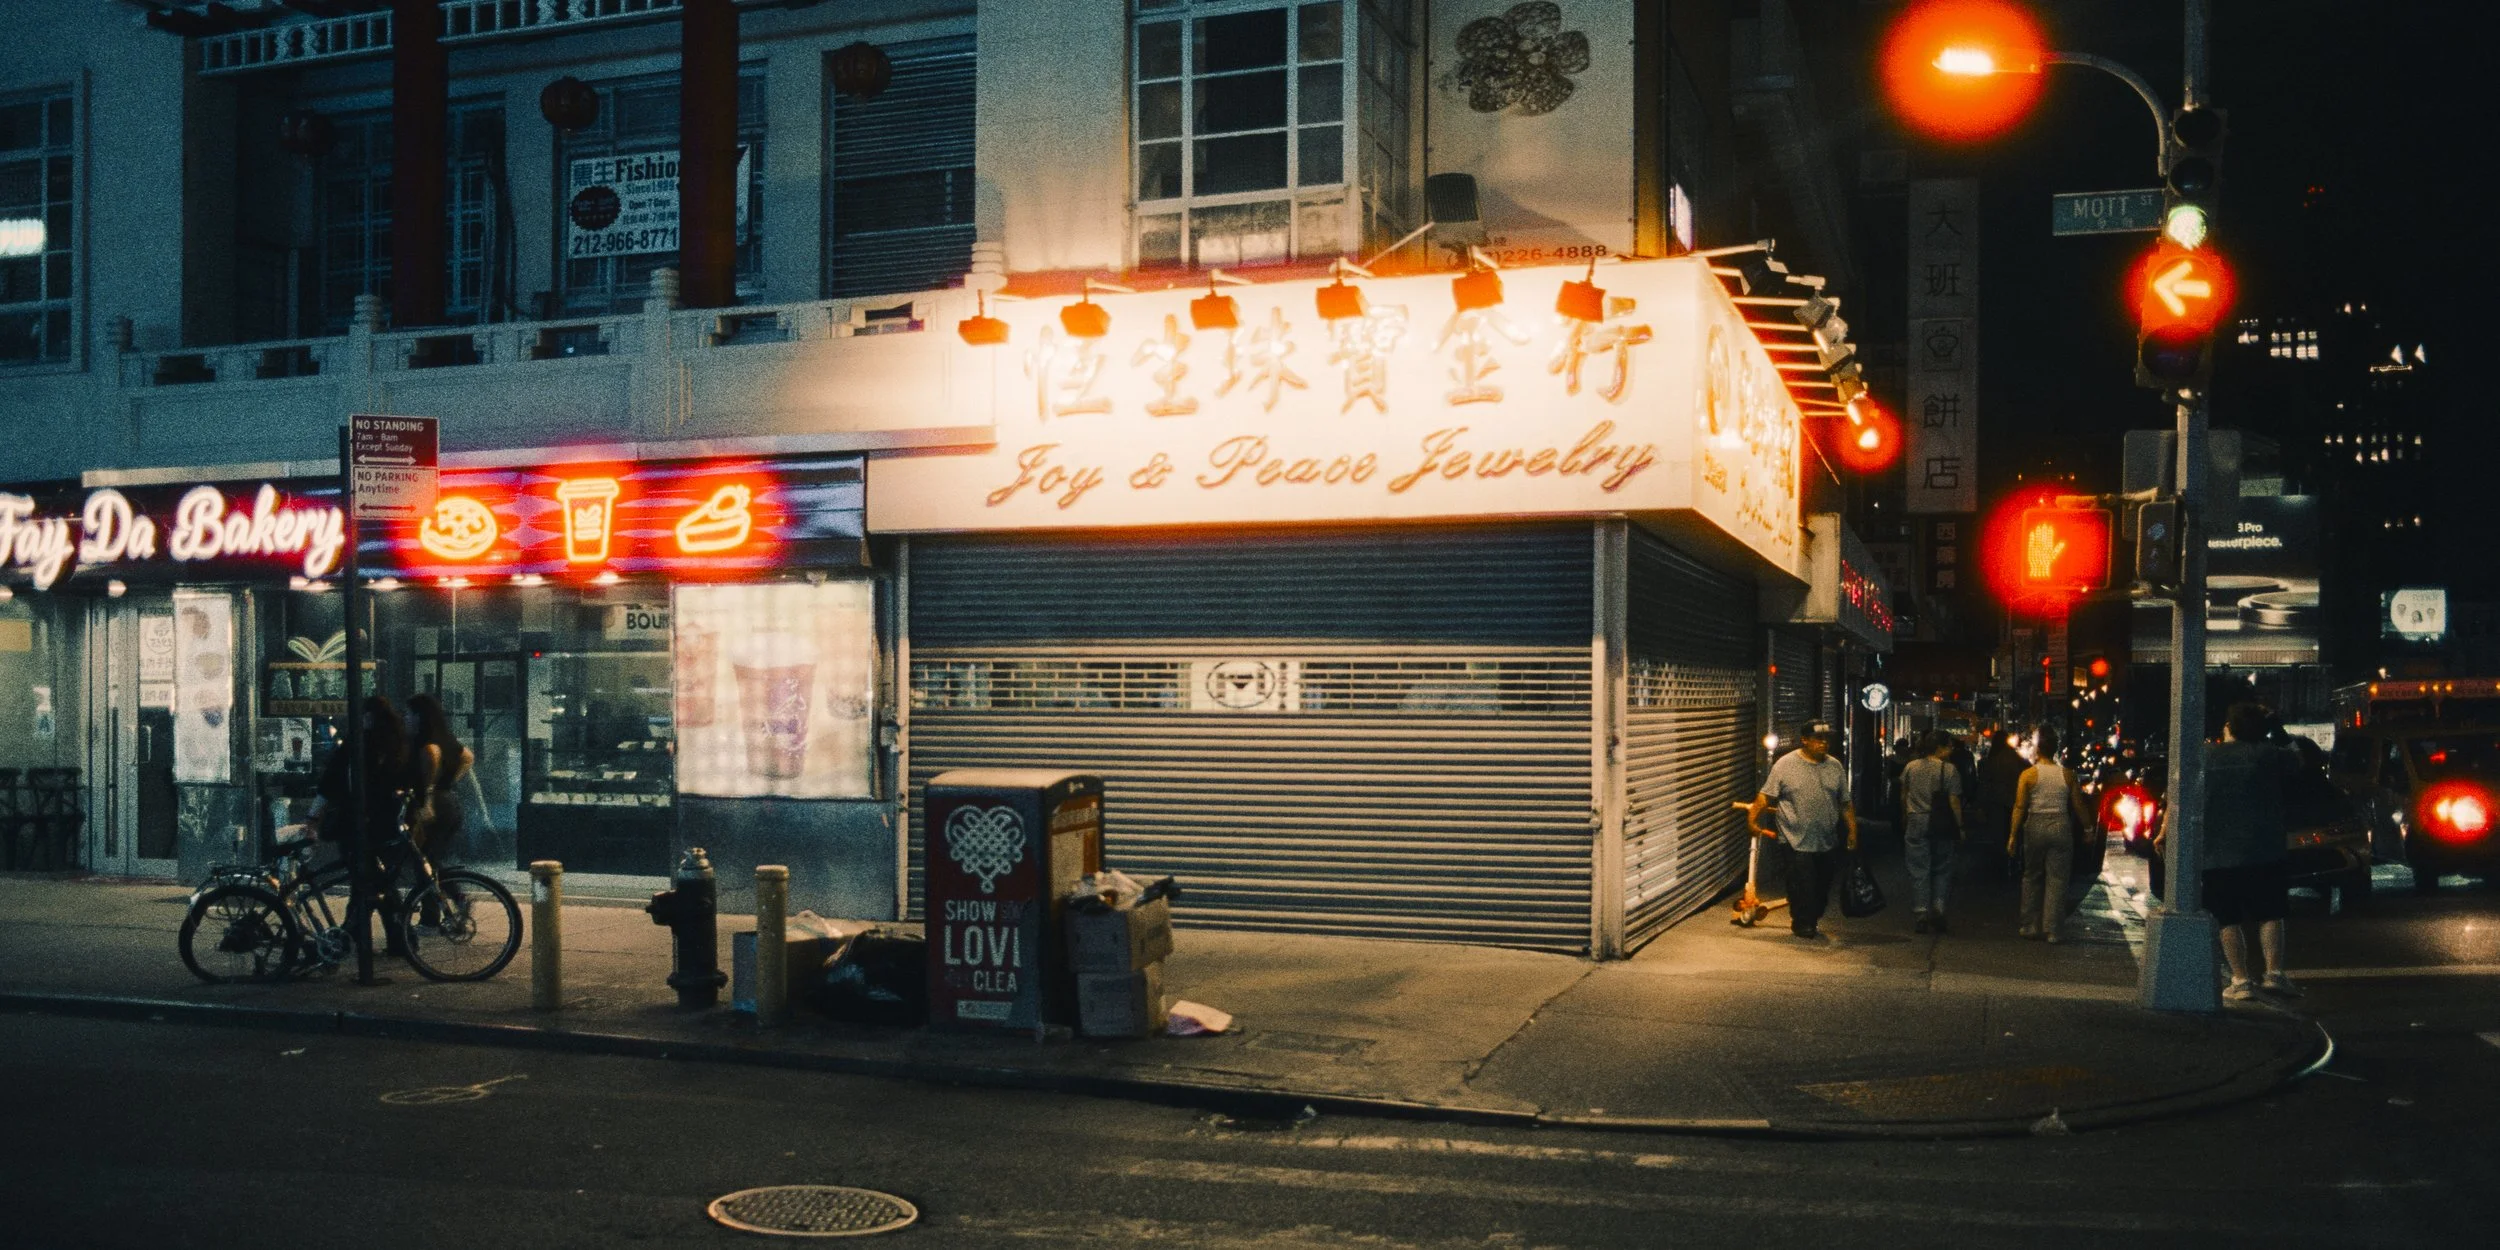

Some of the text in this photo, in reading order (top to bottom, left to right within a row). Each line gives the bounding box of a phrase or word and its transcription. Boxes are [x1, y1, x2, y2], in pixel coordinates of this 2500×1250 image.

[626, 183, 650, 195] Since
[629, 200, 646, 211] Open
[654, 198, 671, 210] Days
[2073, 194, 2154, 219] MOTT ST
[573, 227, 678, 255] 212-966-8771
[355, 420, 425, 432] NO STANDING
[357, 432, 374, 441] 7am
[356, 442, 414, 454] Except Sunday
[986, 441, 1104, 510] Joy
[1129, 451, 1175, 490] &
[1196, 434, 1378, 489] Peace
[1388, 419, 1657, 494] Jewelry
[357, 471, 420, 483] NO PARKING
[358, 484, 401, 495] Anytime
[2245, 522, 2264, 533] Pro
[0, 483, 346, 591] Fay Da Bakery
[944, 899, 998, 922] SHOW
